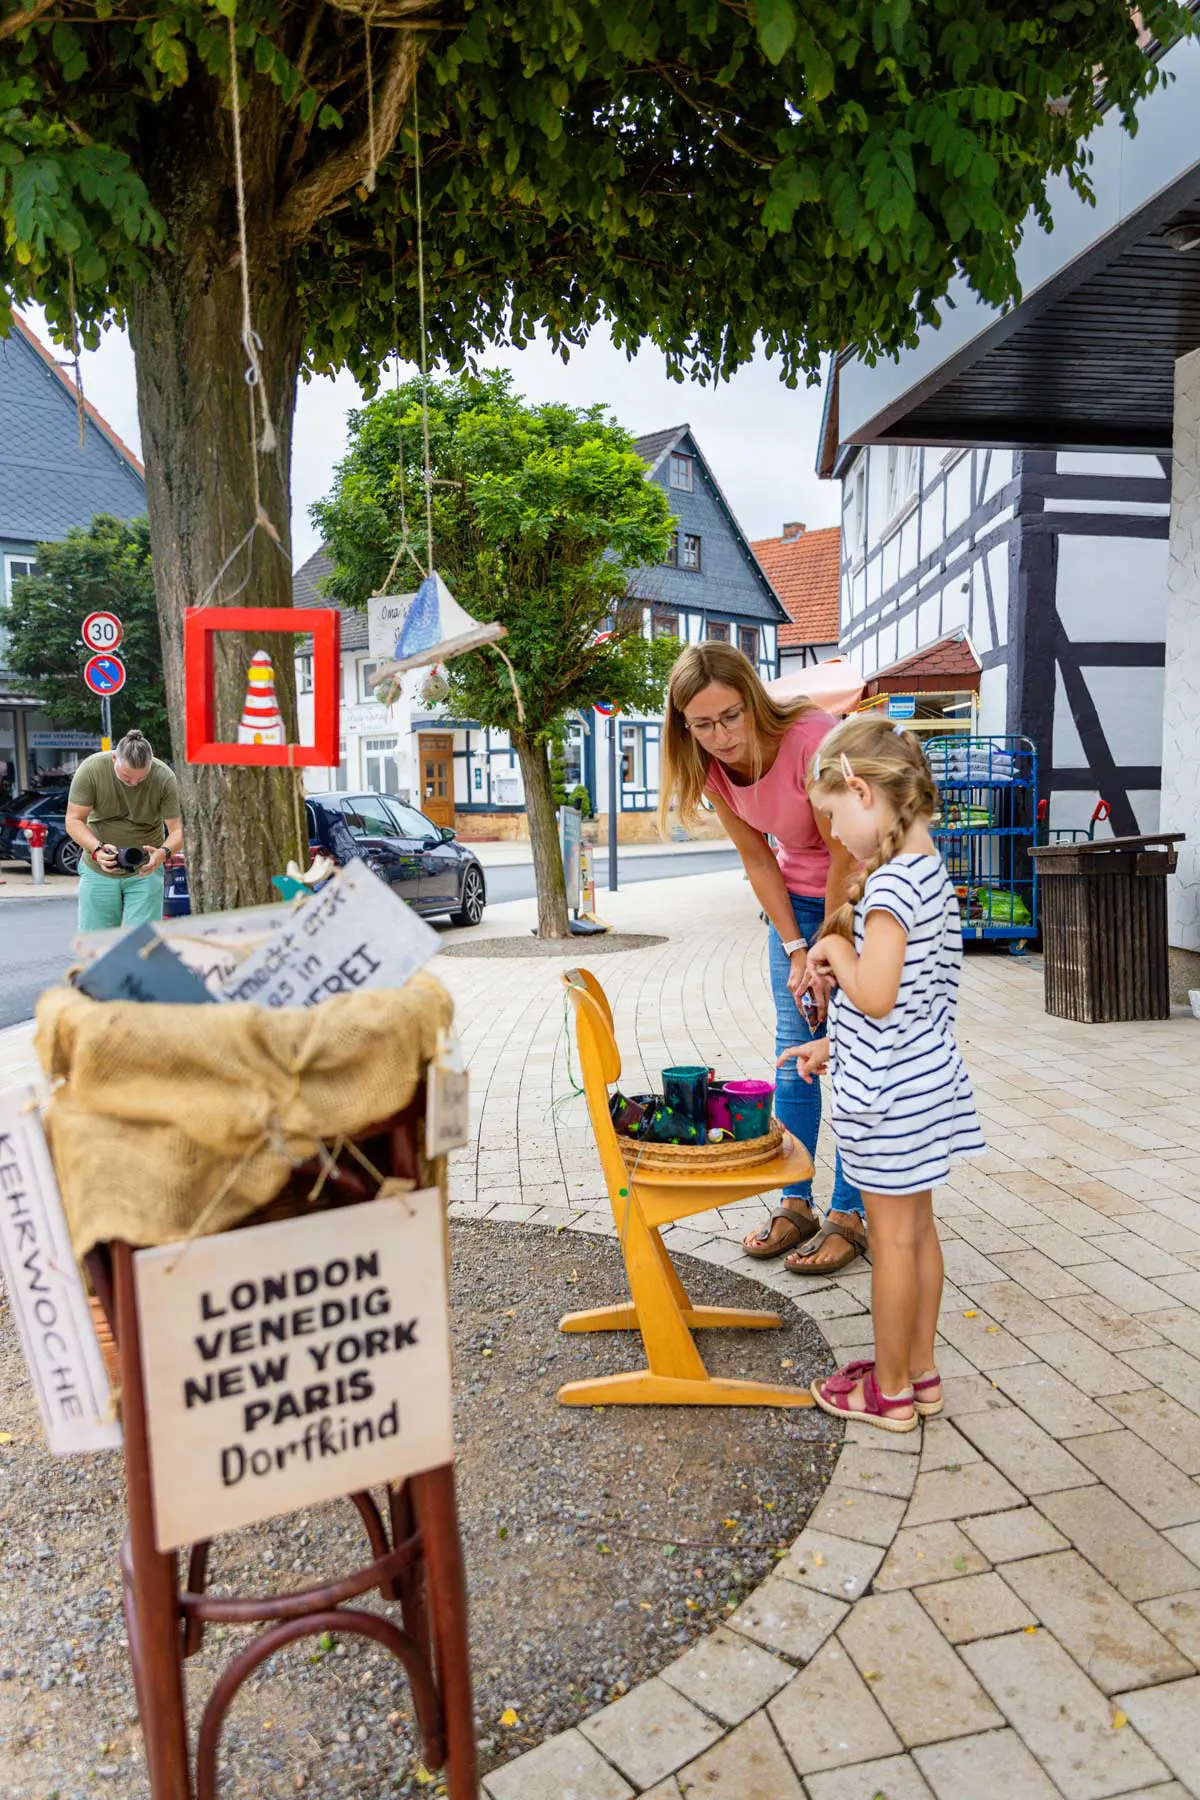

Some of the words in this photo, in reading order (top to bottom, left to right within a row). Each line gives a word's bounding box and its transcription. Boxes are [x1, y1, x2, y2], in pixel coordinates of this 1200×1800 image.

[92, 623, 114, 641] 30
[296, 954, 321, 983] in
[0, 1131, 85, 1422] KEHRWOCHE
[200, 1250, 380, 1322] LONDON
[194, 1286, 392, 1362] VENEDIG
[183, 1355, 290, 1410] NEW
[306, 1317, 420, 1372] YORK
[243, 1369, 375, 1433] PARIS
[220, 1398, 400, 1488] Dorfkind
